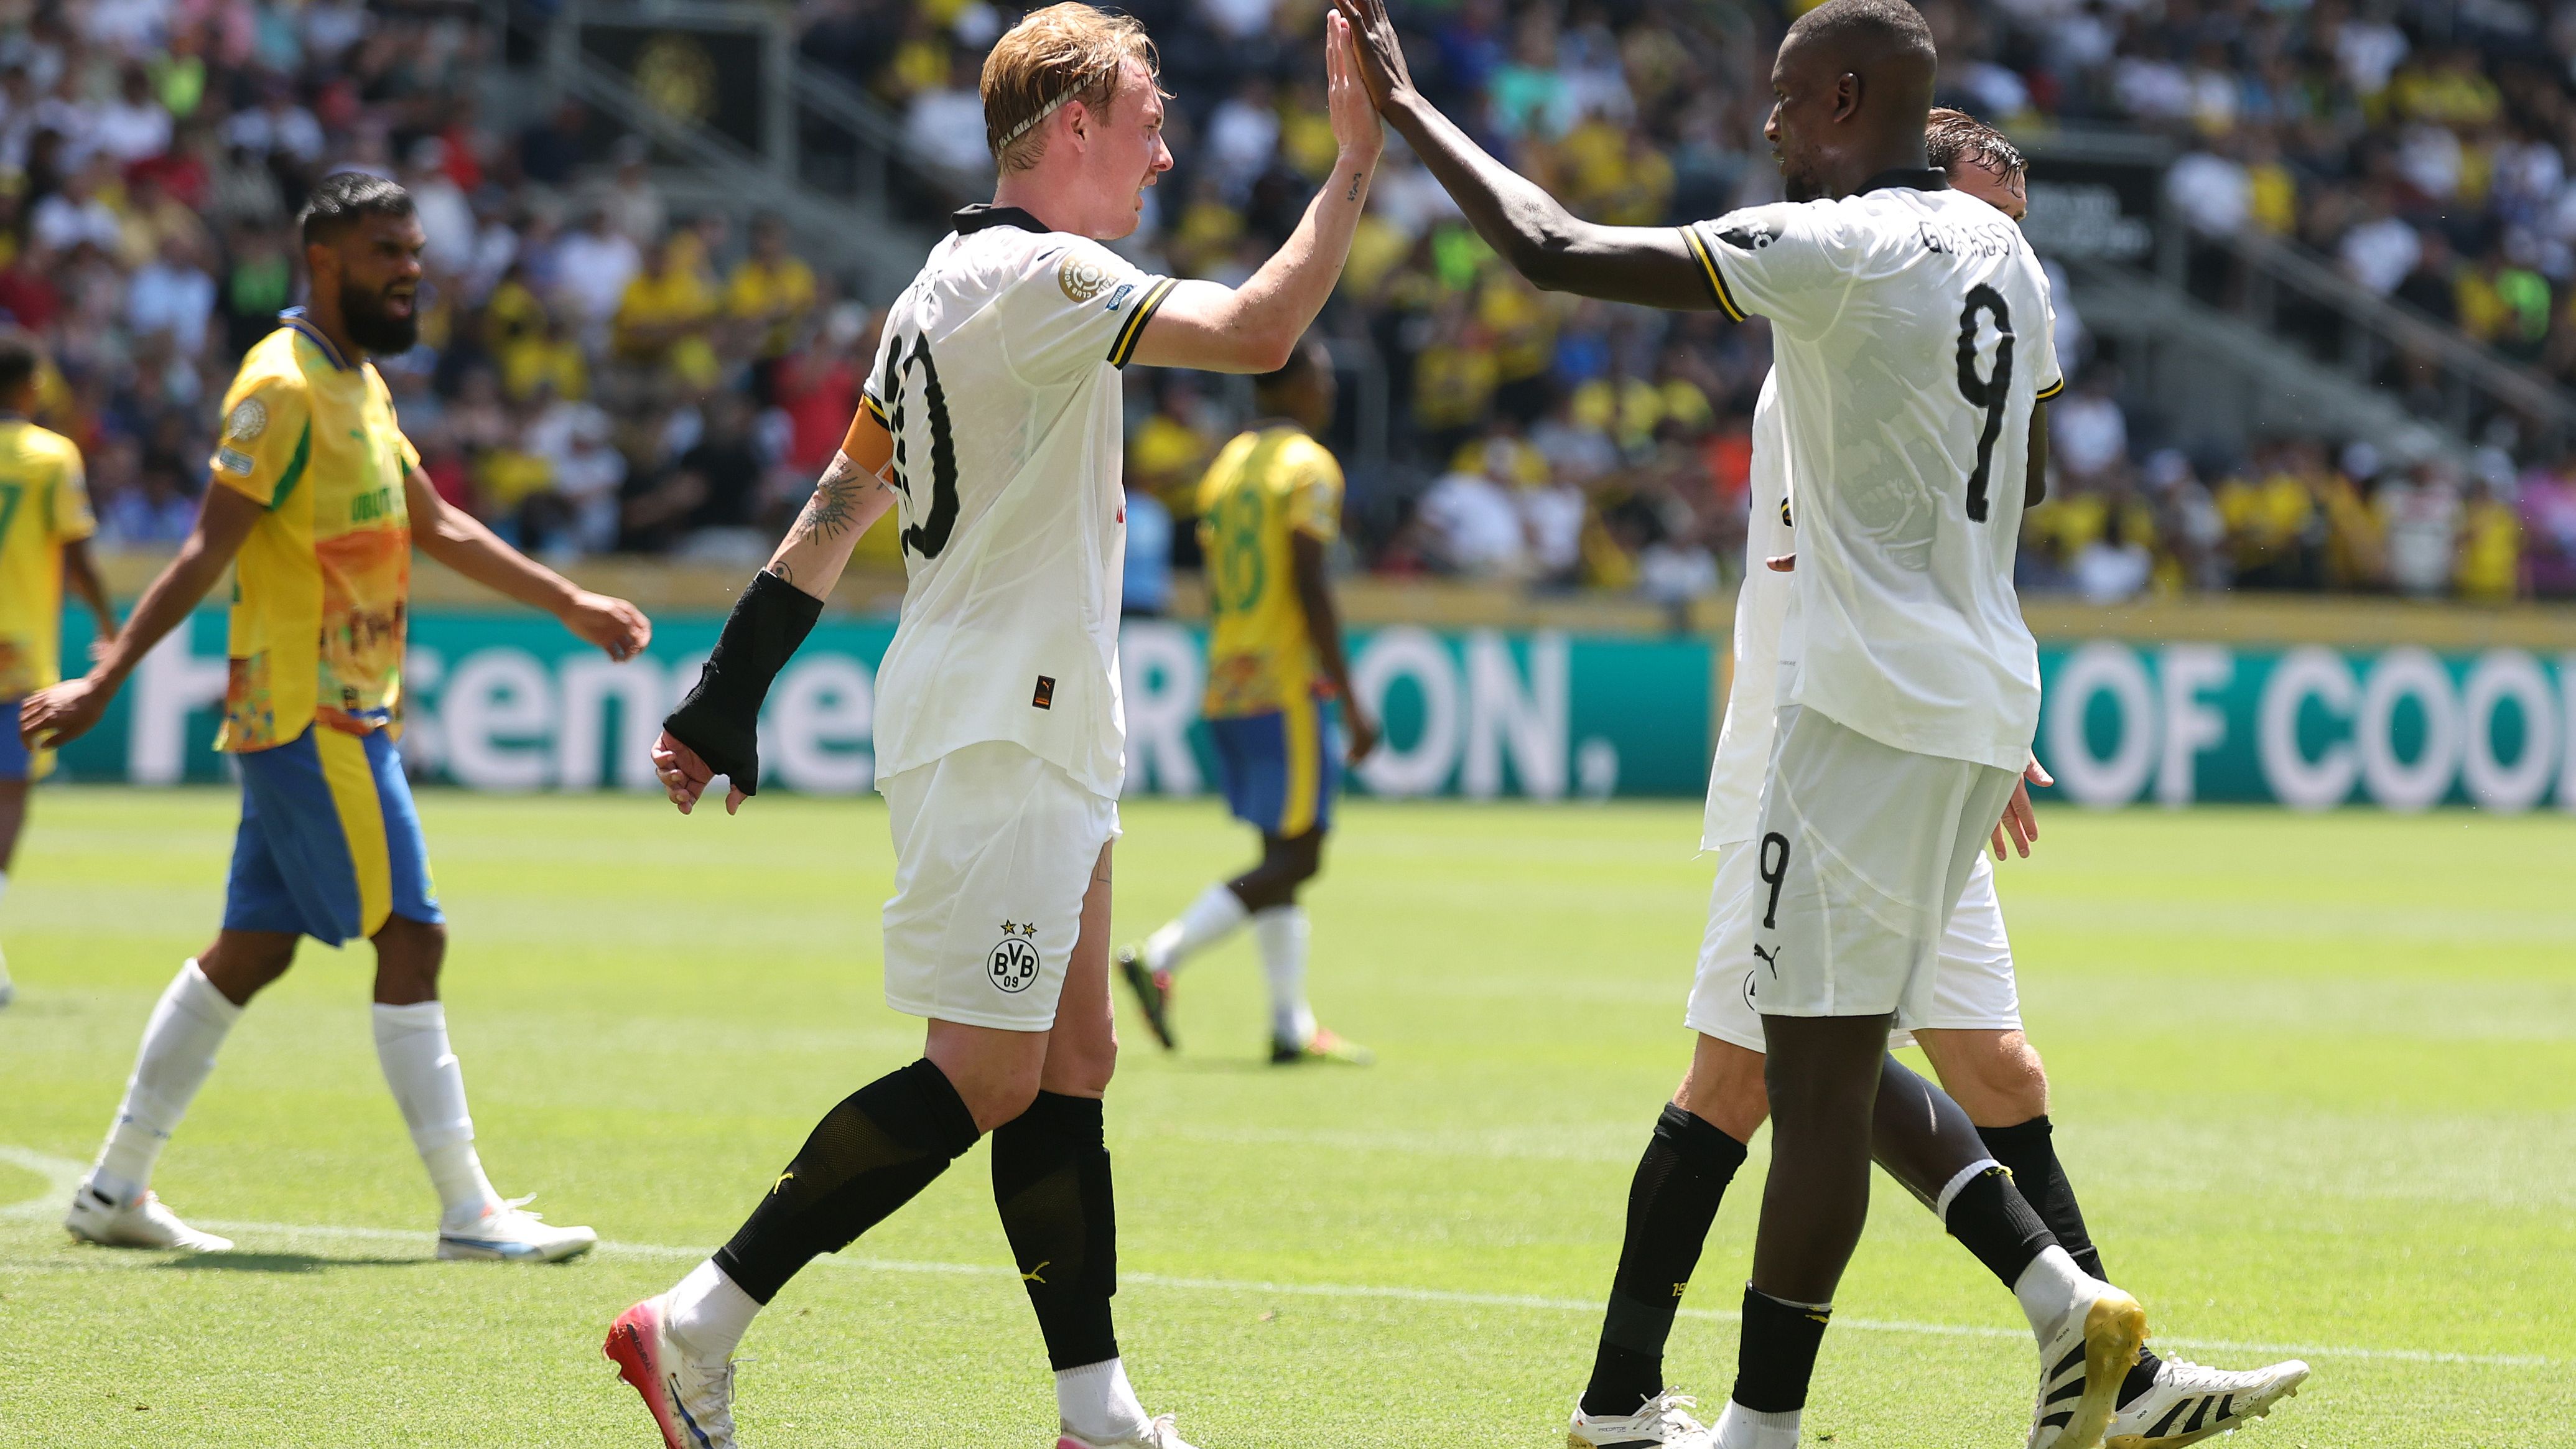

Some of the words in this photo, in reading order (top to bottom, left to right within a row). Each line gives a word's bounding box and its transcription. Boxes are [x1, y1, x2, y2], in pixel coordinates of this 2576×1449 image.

[1064, 260, 1076, 289] WORLD
[1096, 277, 1117, 295] FIFA
[1072, 288, 1092, 299] CLUB
[1956, 282, 2017, 524] 9
[1208, 488, 1265, 613] 8
[131, 613, 873, 789] Hene
[1341, 627, 1619, 804] ON,
[2047, 638, 2234, 811] OF
[2256, 643, 2576, 814] COO
[1760, 832, 1790, 930] 9
[994, 943, 1034, 977] BVB
[1004, 976, 1018, 987] 09
